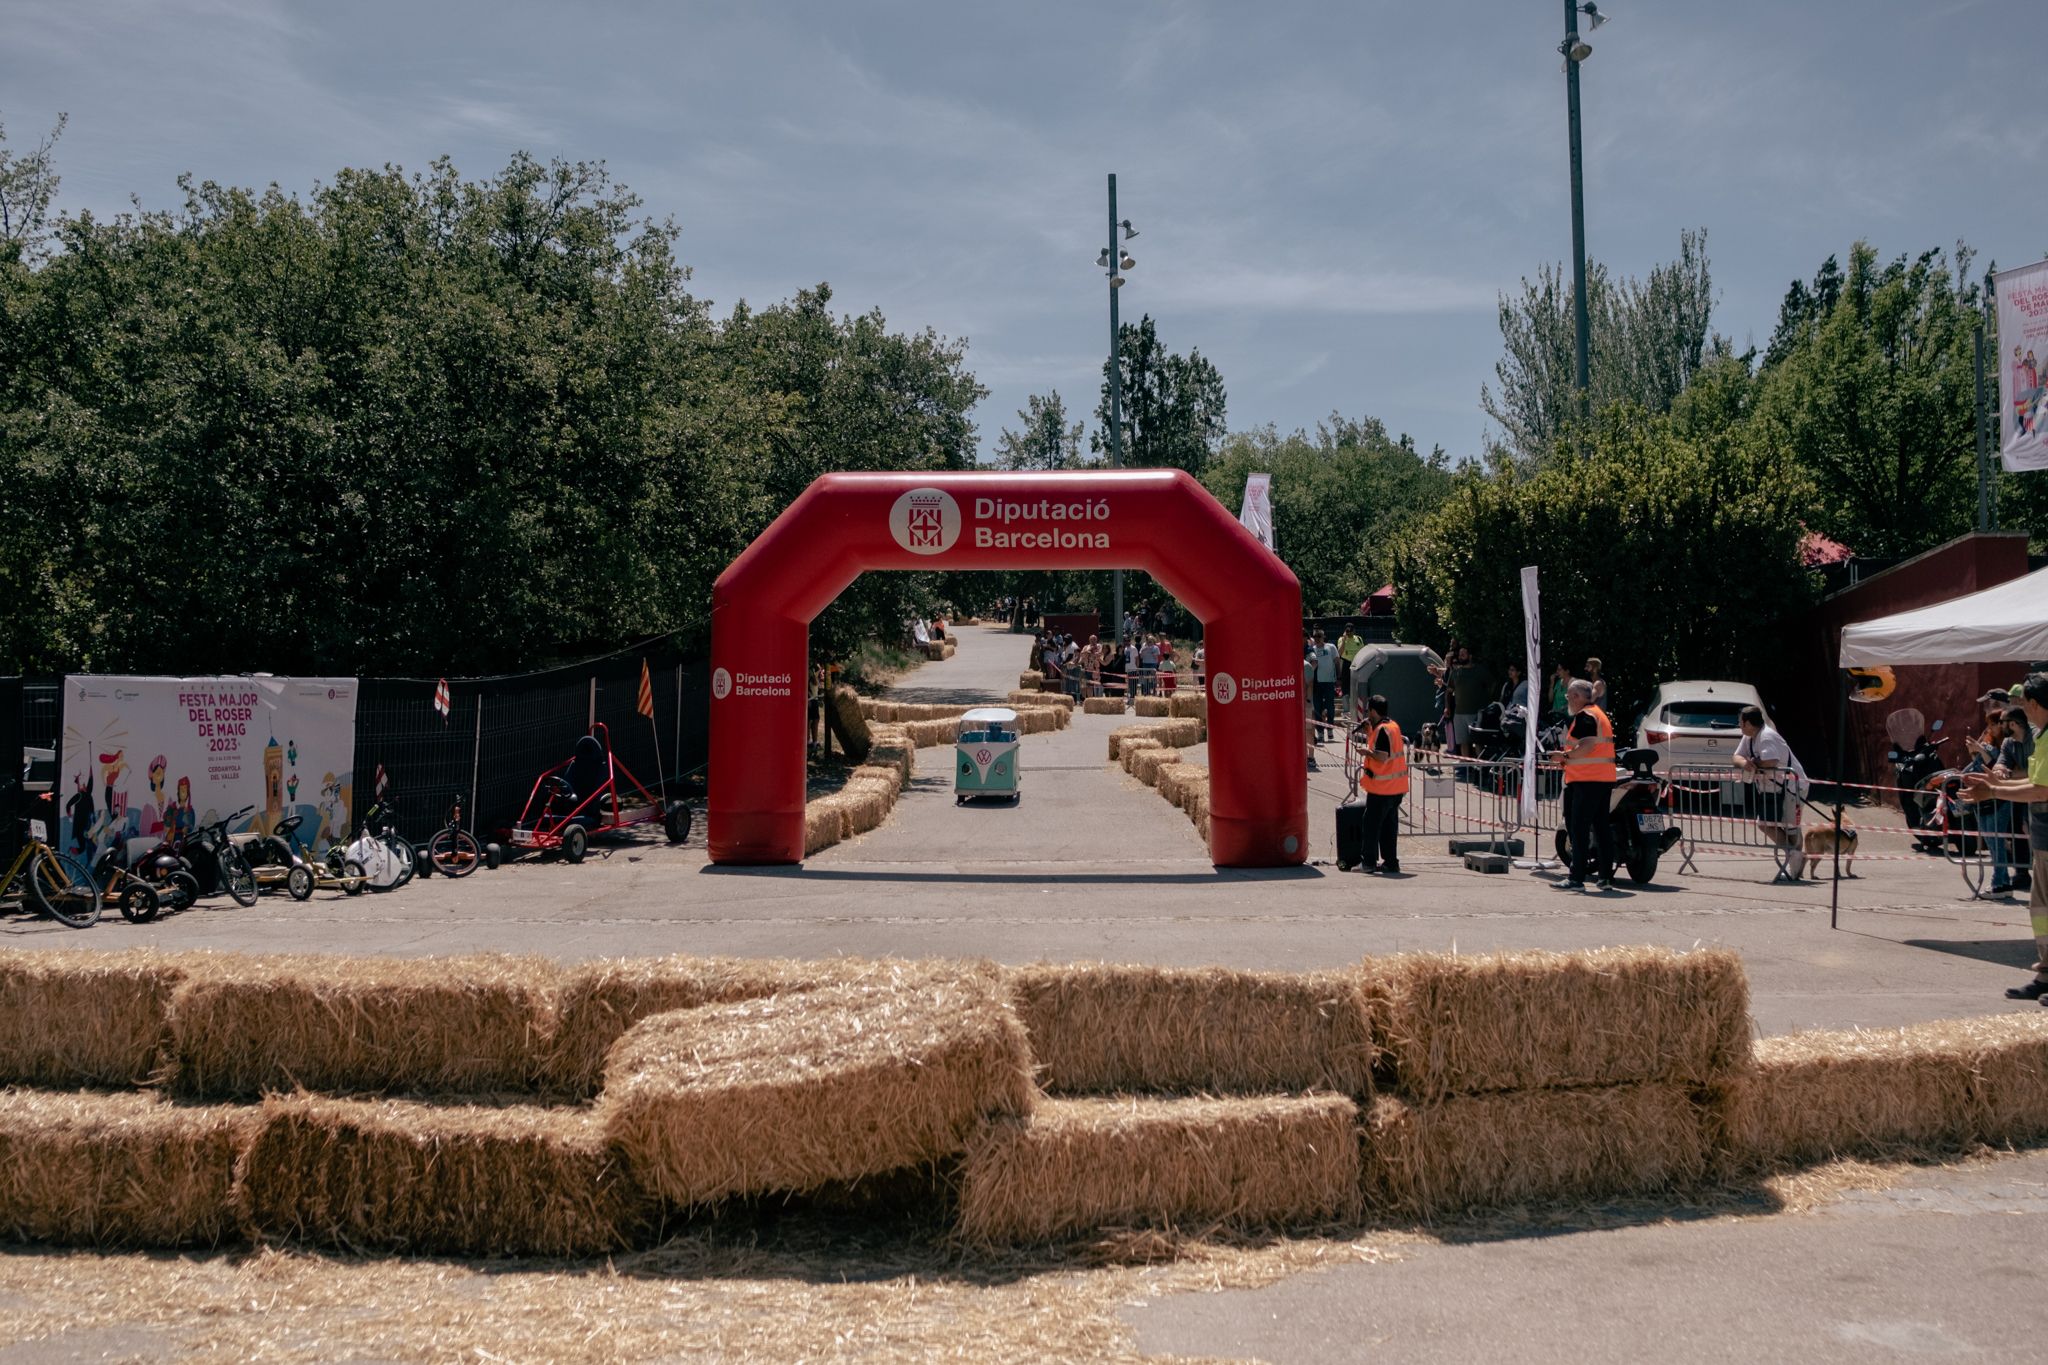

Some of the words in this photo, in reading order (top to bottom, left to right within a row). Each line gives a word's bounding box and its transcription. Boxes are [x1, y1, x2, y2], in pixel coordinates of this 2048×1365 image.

[2032, 292, 2048, 302] ROS
[2020, 304, 2031, 312] DE
[975, 498, 1110, 524] Diputació
[975, 527, 1110, 548] Barcelona
[736, 673, 791, 685] Diputació
[1242, 675, 1295, 690] Diputació
[736, 685, 791, 696] Barcelona
[1242, 690, 1295, 701] Barcelona
[179, 694, 216, 707] FESTA
[220, 693, 258, 706] MAJOR
[189, 709, 211, 722] DEL
[215, 708, 252, 720] ROSER
[199, 724, 214, 736] DE
[218, 723, 246, 736] MAIG
[210, 738, 238, 752] 2023
